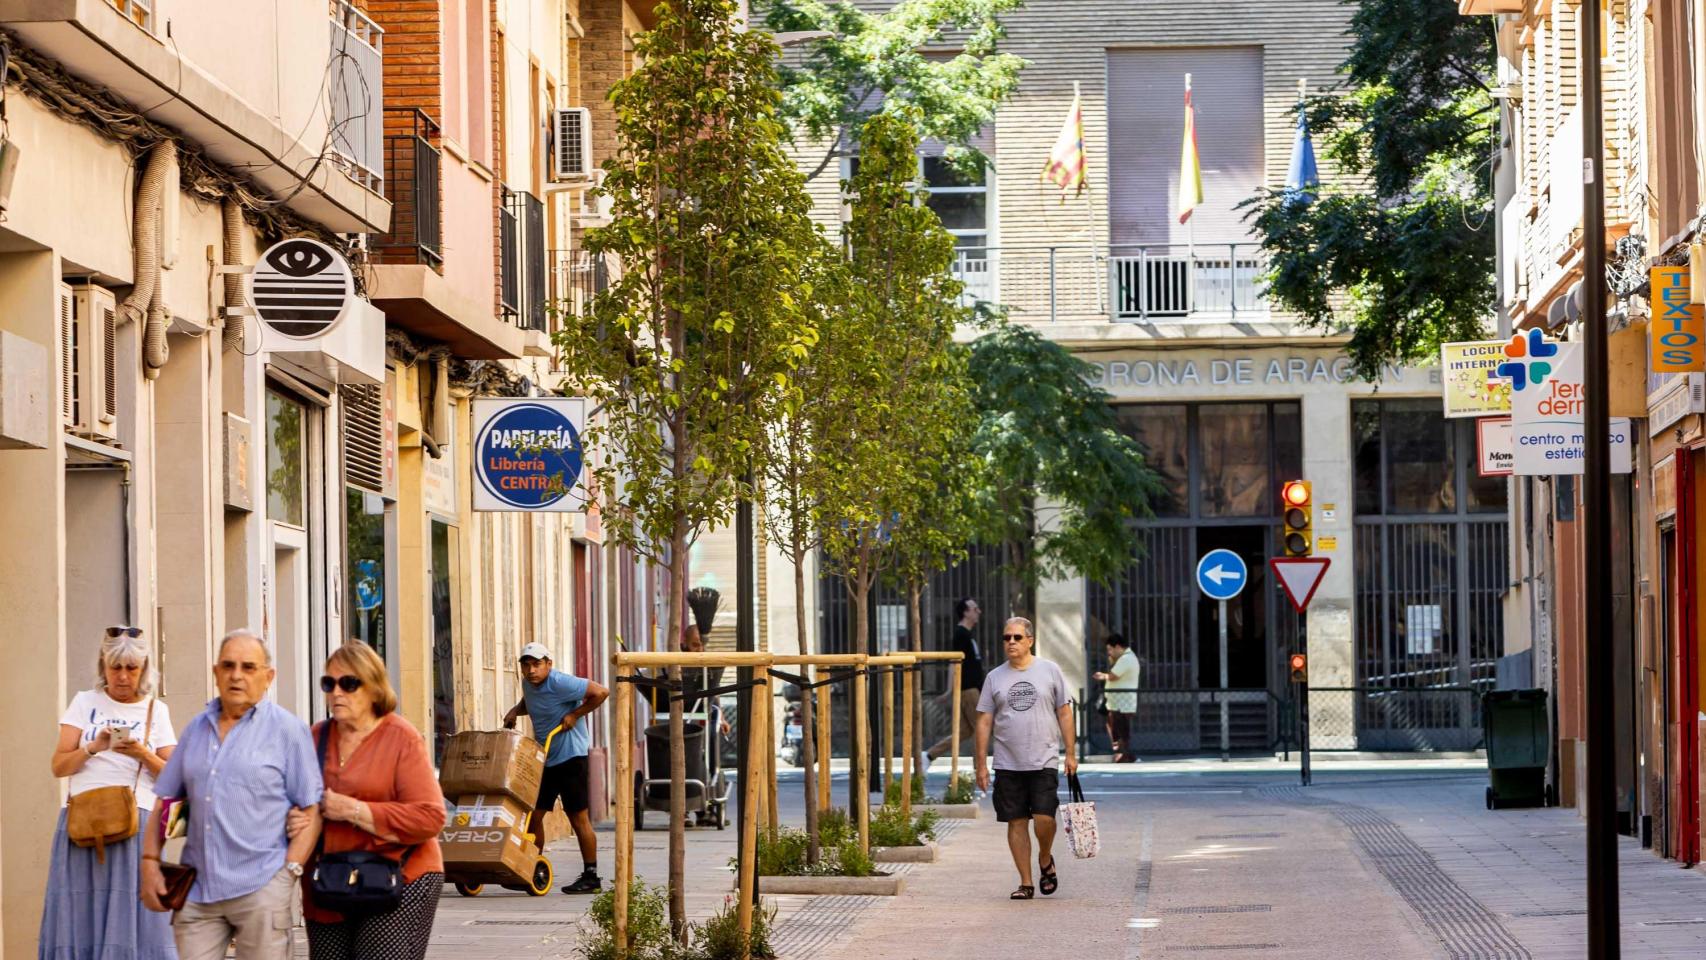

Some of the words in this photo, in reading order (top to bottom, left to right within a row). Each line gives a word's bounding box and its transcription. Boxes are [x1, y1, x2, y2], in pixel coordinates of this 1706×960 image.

[1661, 272, 1697, 365] TEXTOS
[1462, 345, 1503, 357] LOCUT
[1211, 359, 1253, 385] DE
[1265, 356, 1404, 384] ARAGN
[1520, 433, 1565, 445] centro
[490, 457, 545, 471] Librería
[438, 831, 504, 843] CREA
